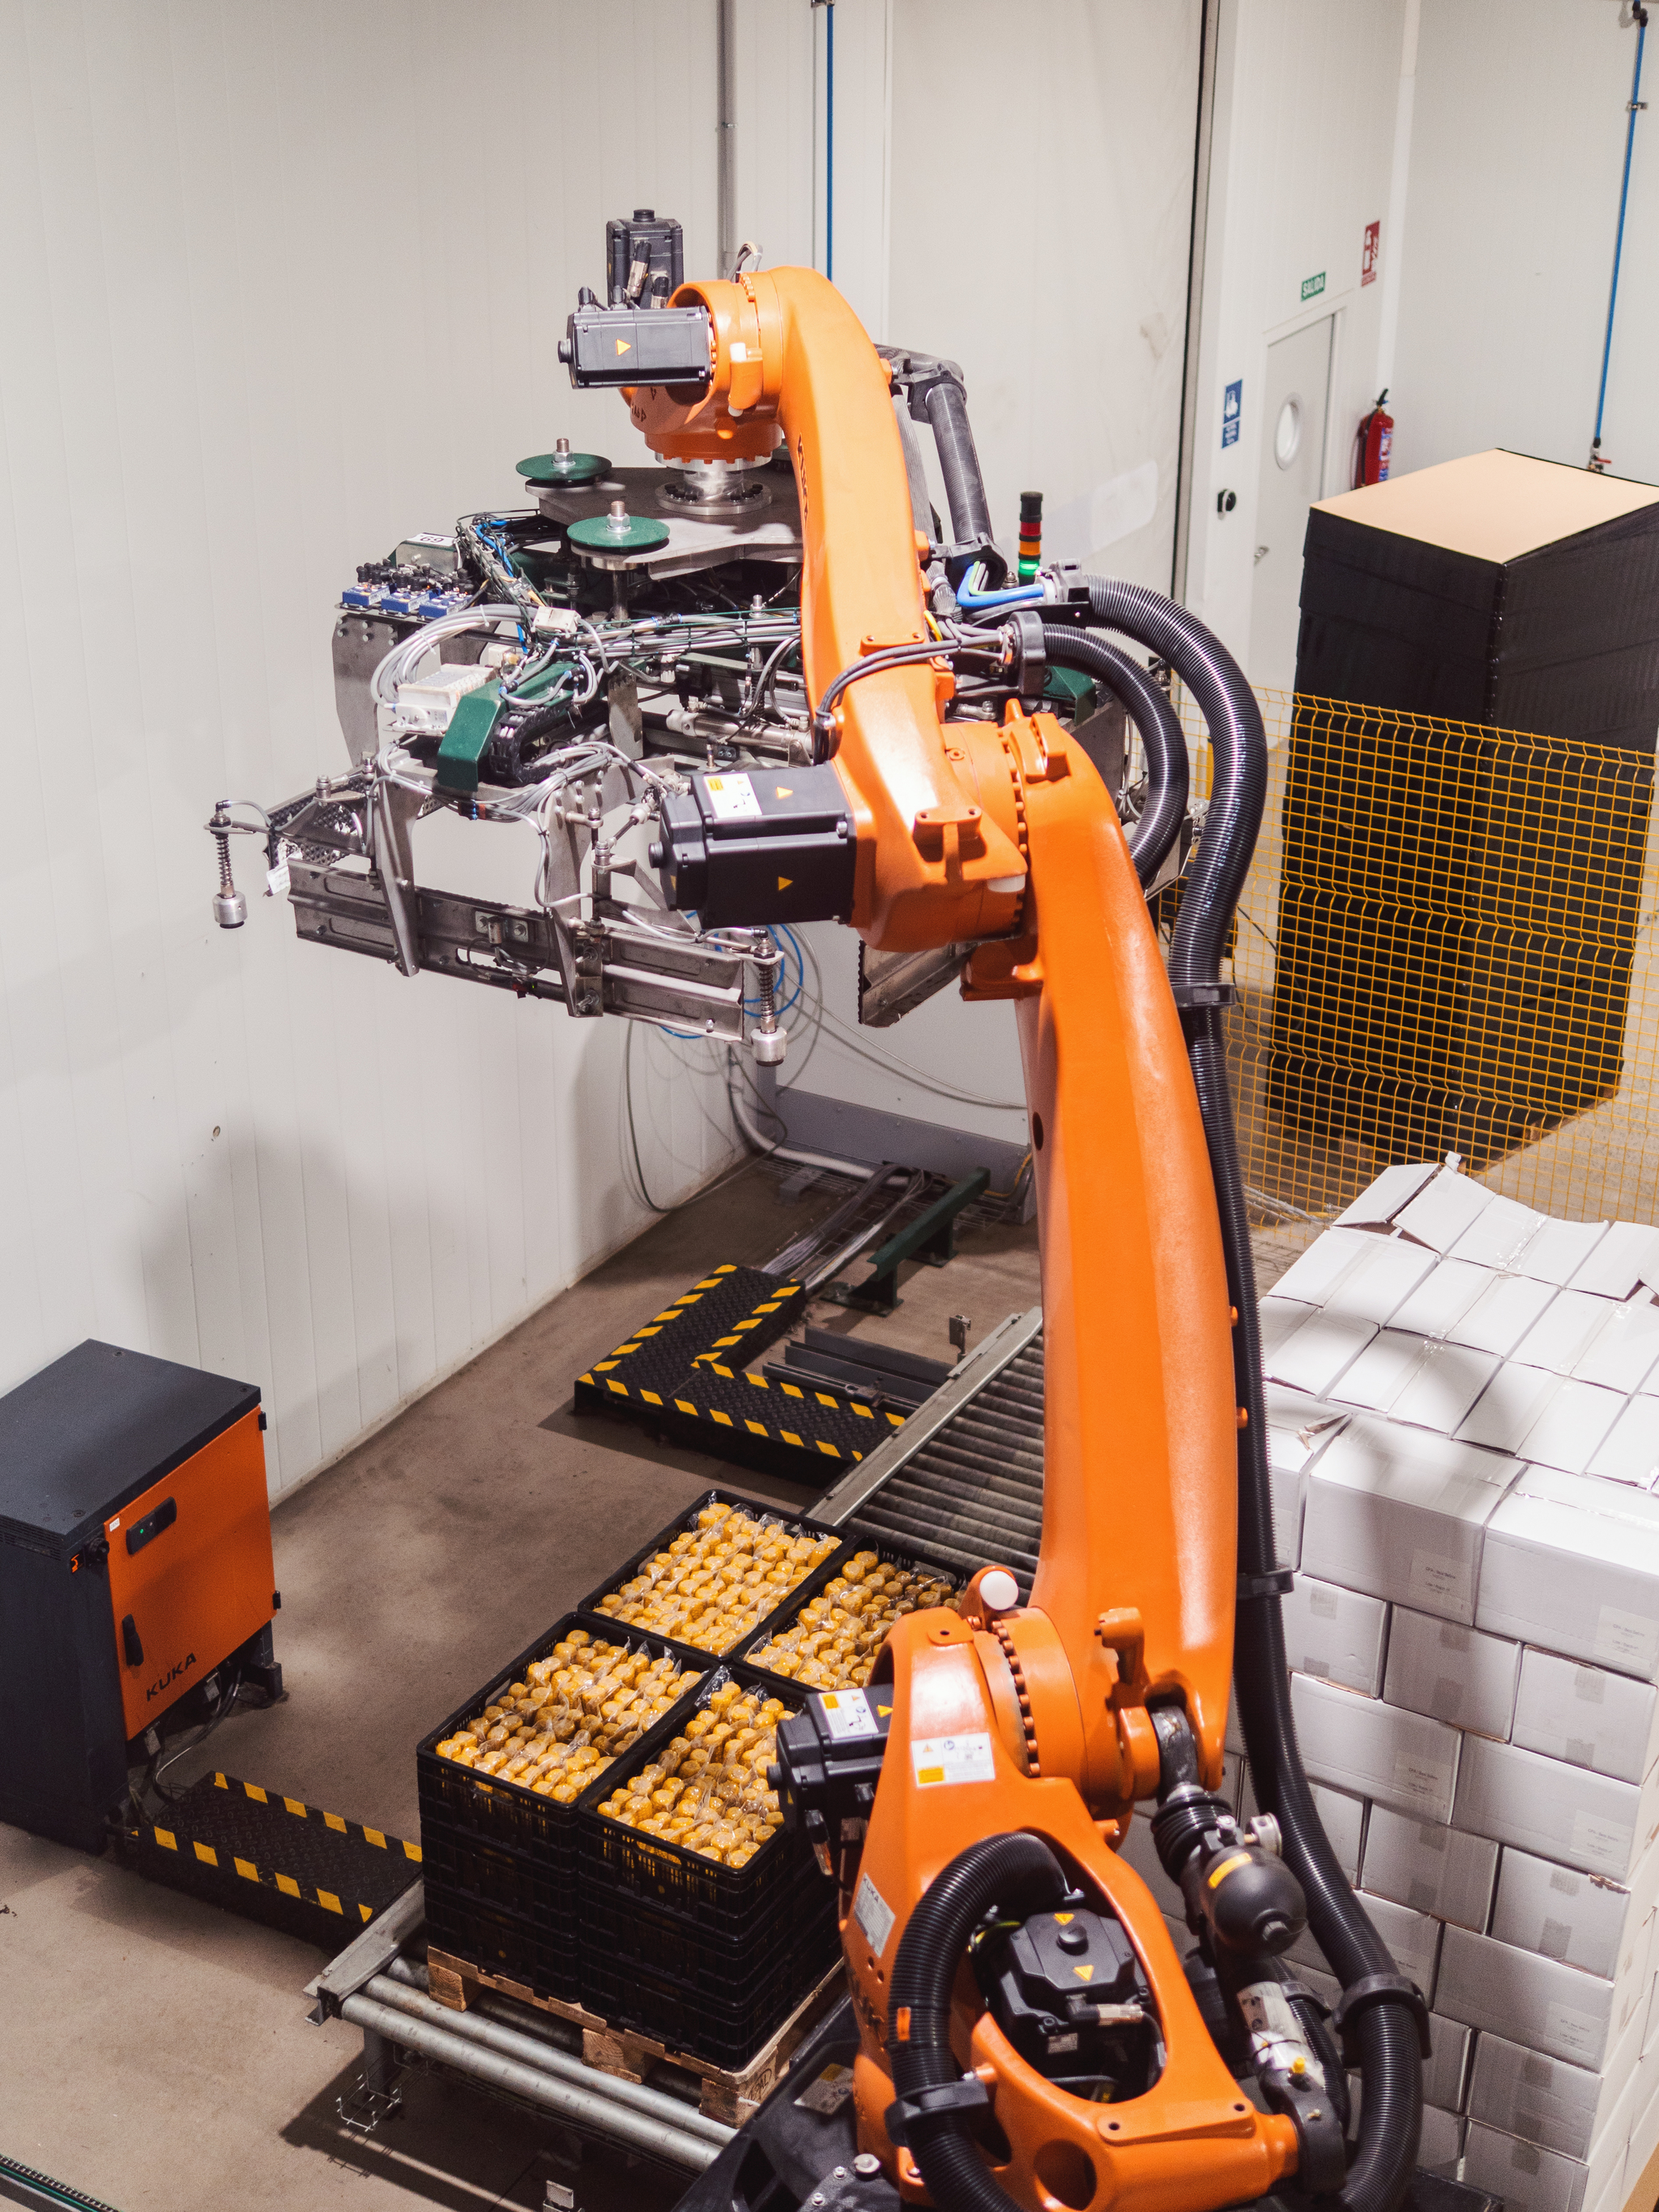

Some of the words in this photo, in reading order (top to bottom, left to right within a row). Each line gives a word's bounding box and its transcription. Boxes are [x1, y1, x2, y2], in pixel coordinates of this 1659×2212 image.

[1303, 275, 1324, 297] SALIDA
[147, 1652, 197, 1702] KUKA
[864, 1877, 879, 1902] KUKA
